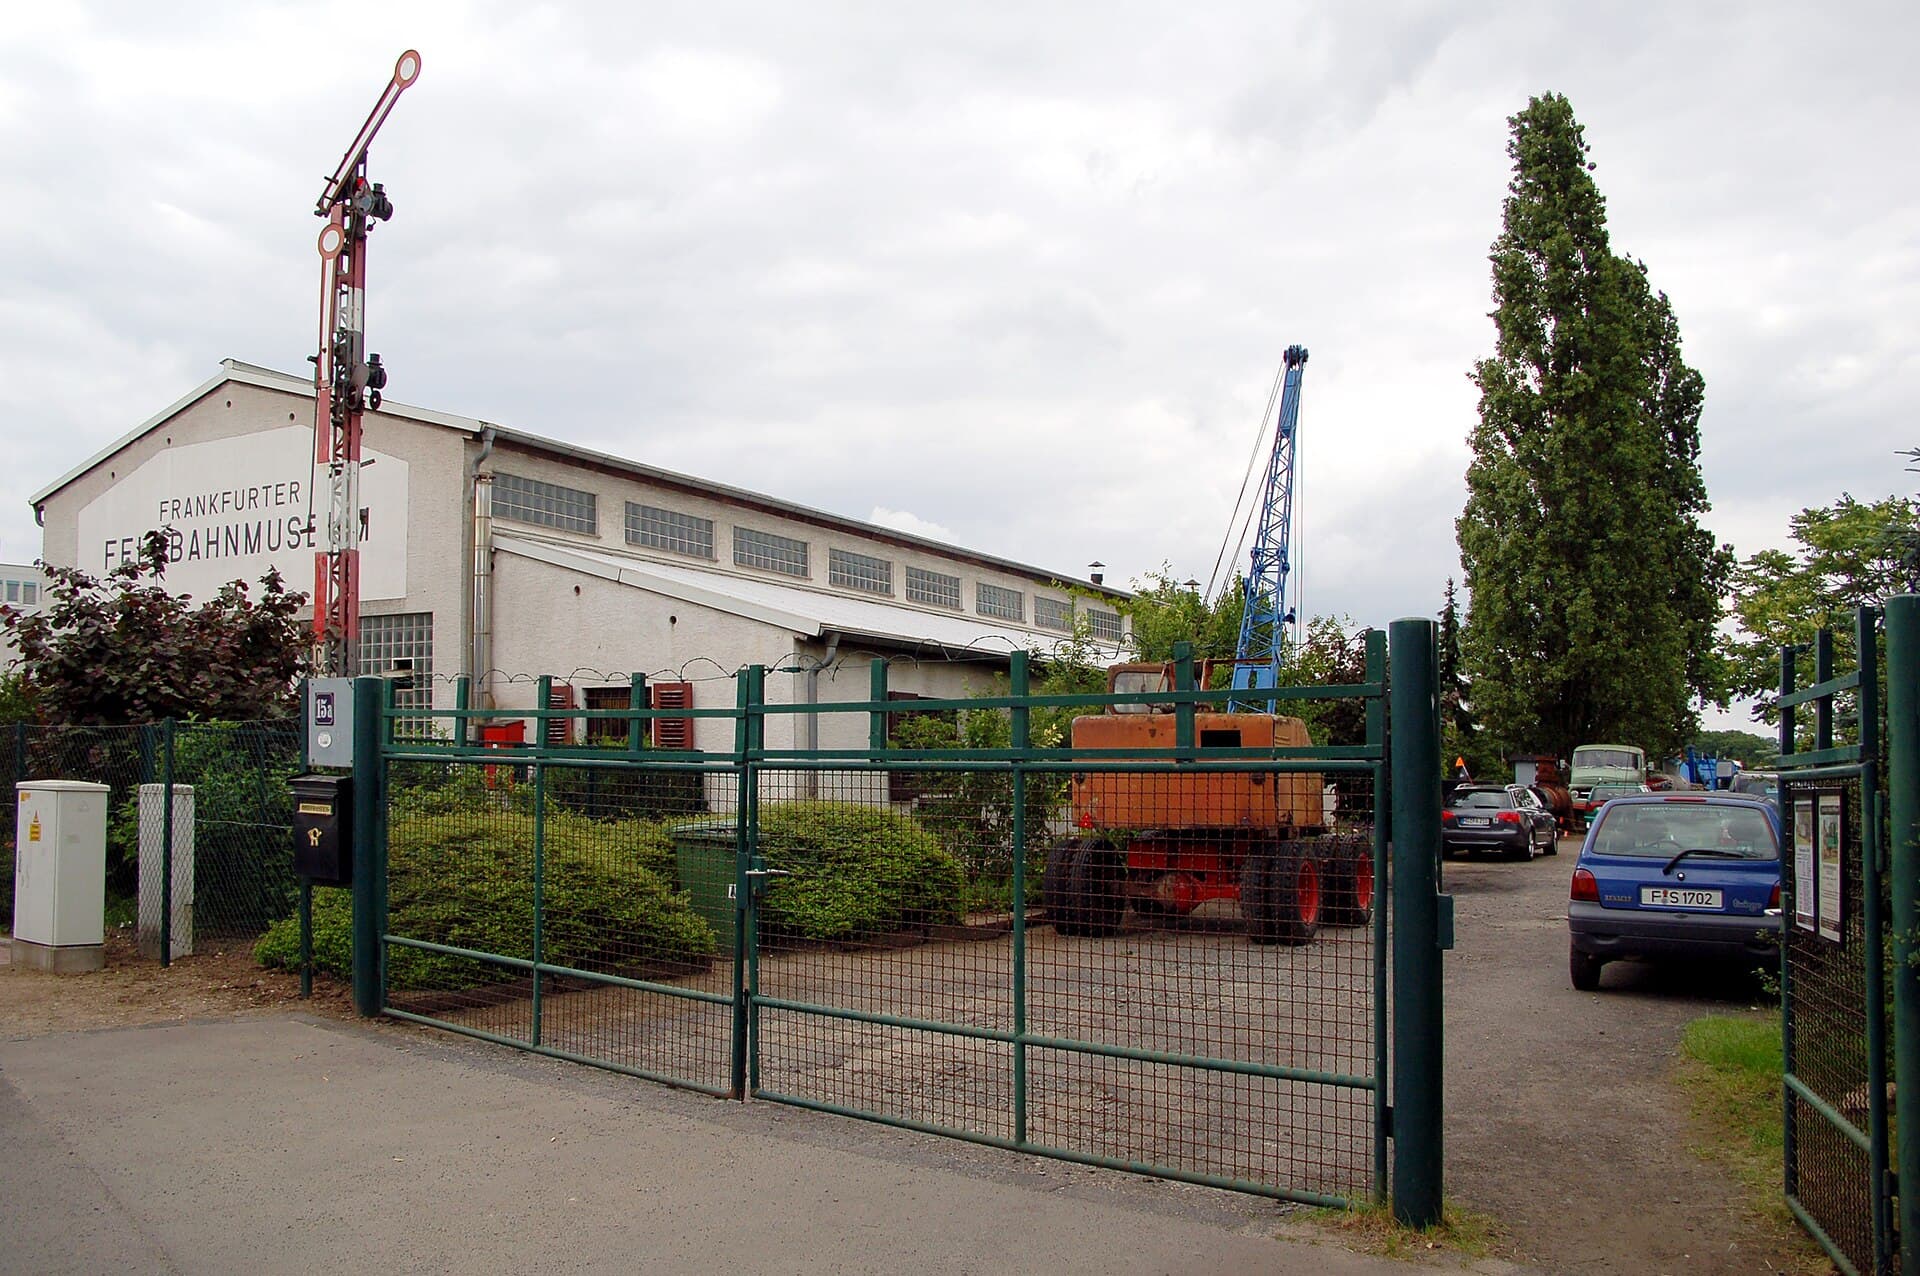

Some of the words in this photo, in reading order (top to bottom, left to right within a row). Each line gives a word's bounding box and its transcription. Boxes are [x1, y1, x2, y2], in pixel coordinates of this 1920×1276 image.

[159, 480, 301, 522] FRANKFURTER
[316, 698, 333, 719] 15a
[1651, 890, 1662, 903] F
[1682, 892, 1713, 905] 1702
